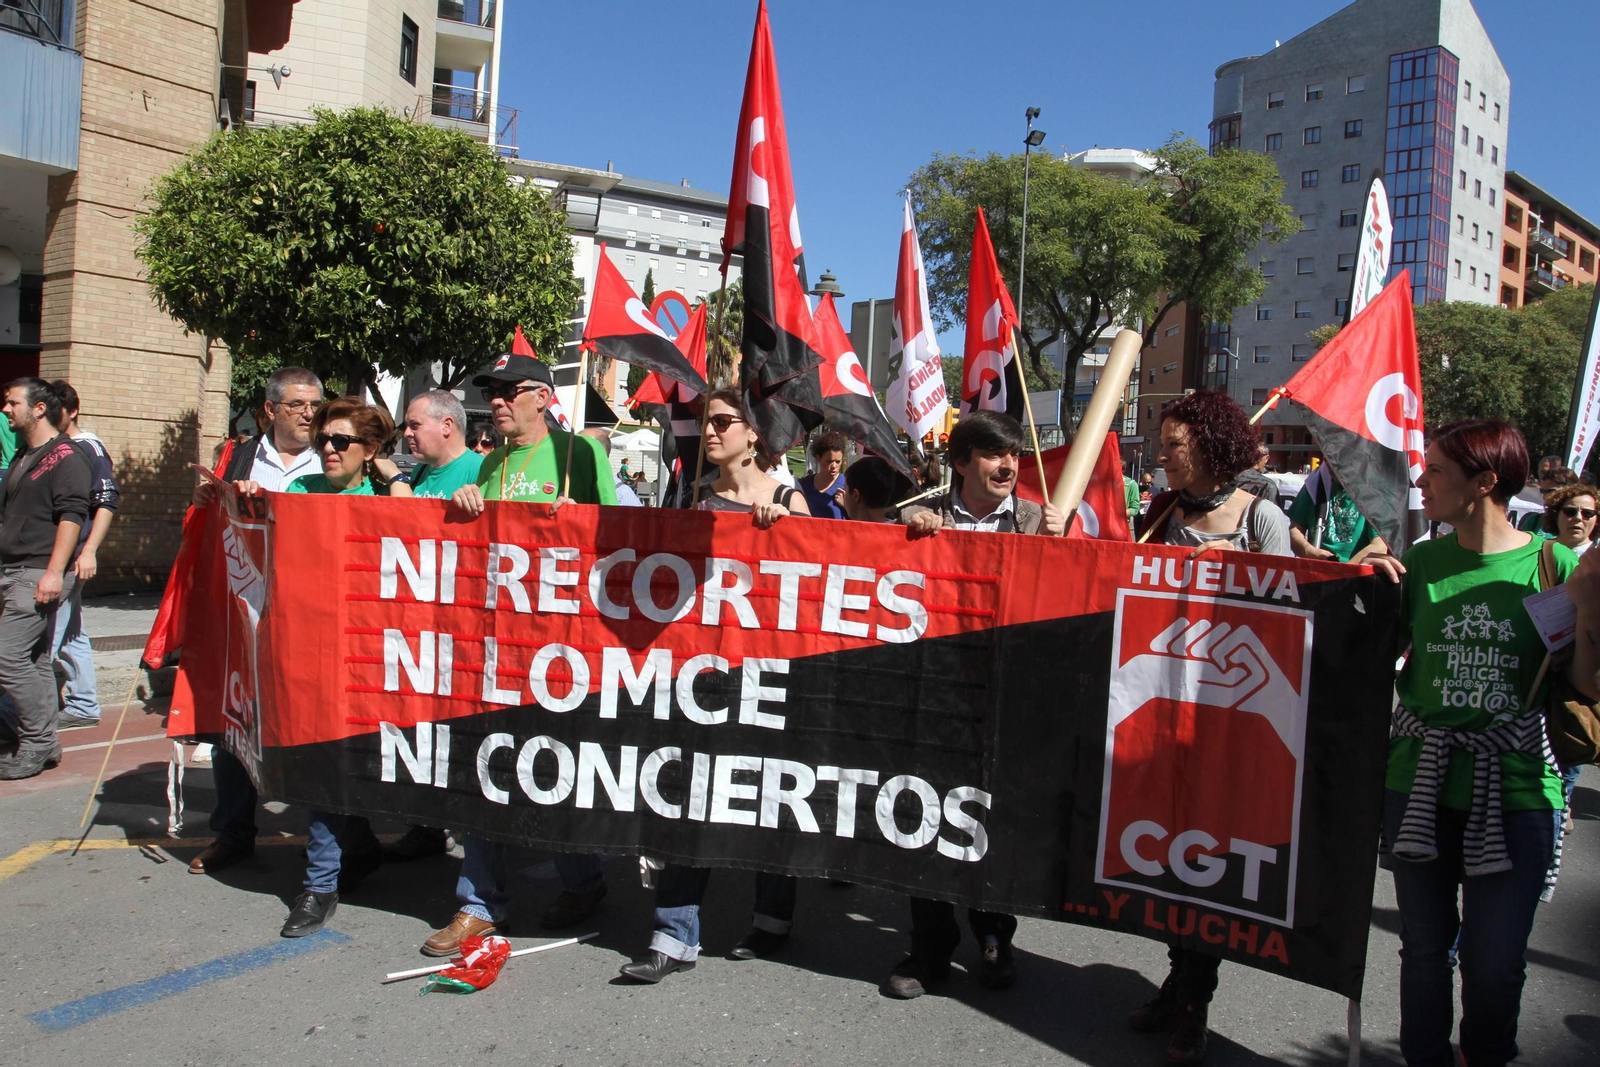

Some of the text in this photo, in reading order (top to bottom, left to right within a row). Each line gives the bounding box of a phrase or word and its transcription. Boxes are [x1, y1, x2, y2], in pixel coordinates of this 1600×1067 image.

[380, 537, 929, 644] NI RECORTES
[1132, 555, 1301, 603] HUELVA
[1426, 641, 1465, 653] Escuela
[1446, 646, 1520, 669] pública
[384, 629, 791, 731] NI LOMCE
[1432, 676, 1442, 687] de
[1443, 677, 1480, 690] tod@s
[1482, 681, 1490, 691] y
[1453, 661, 1506, 682] laica:
[1440, 684, 1520, 714] tod@s
[379, 721, 992, 863] NI CONCIERTOS
[1119, 819, 1277, 901] CGT
[1143, 898, 1290, 966] LUCHA
